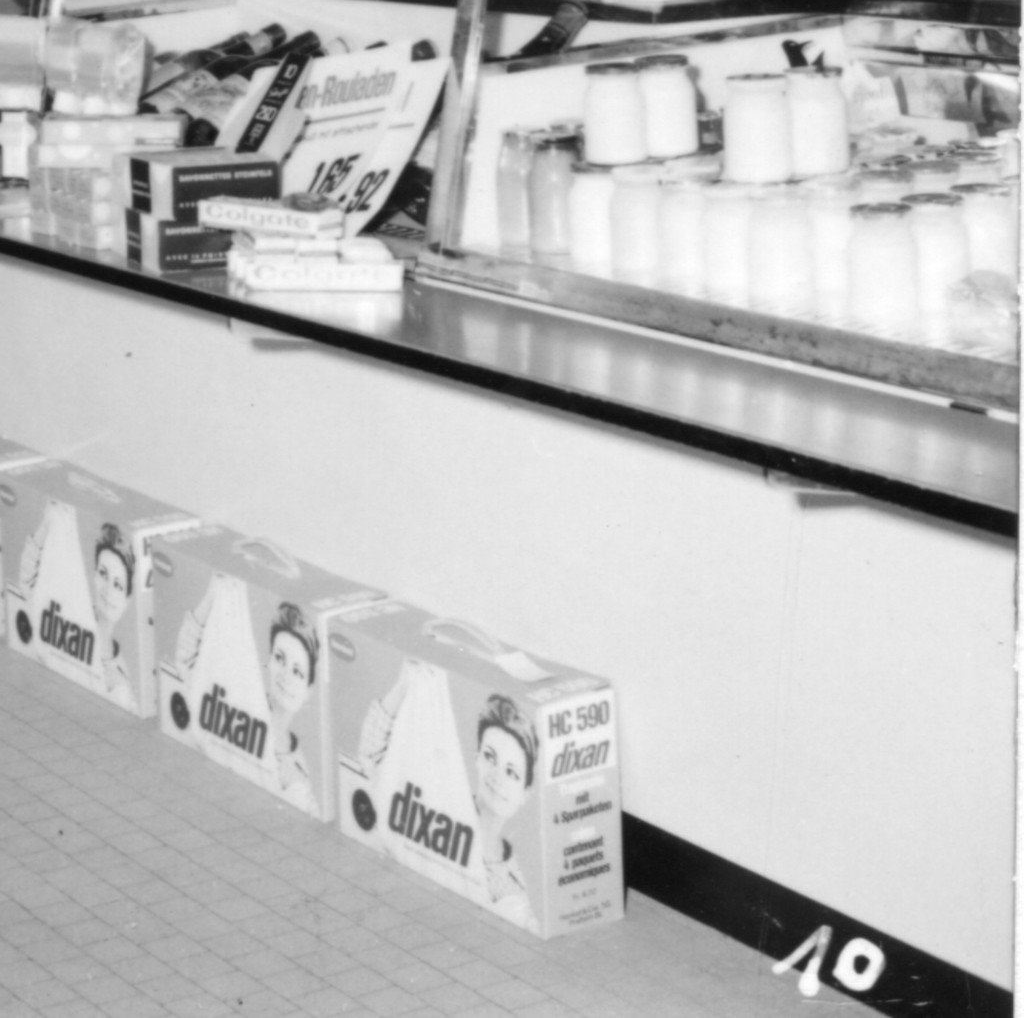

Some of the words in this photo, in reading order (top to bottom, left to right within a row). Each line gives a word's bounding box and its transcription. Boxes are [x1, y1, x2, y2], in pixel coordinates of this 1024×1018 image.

[205, 202, 311, 230] Colgate
[39, 599, 96, 667] dixan
[199, 683, 268, 760] dixan
[548, 709, 573, 740] HC
[575, 699, 611, 732] 590
[551, 738, 611, 779] dixan
[388, 781, 475, 868] dixan
